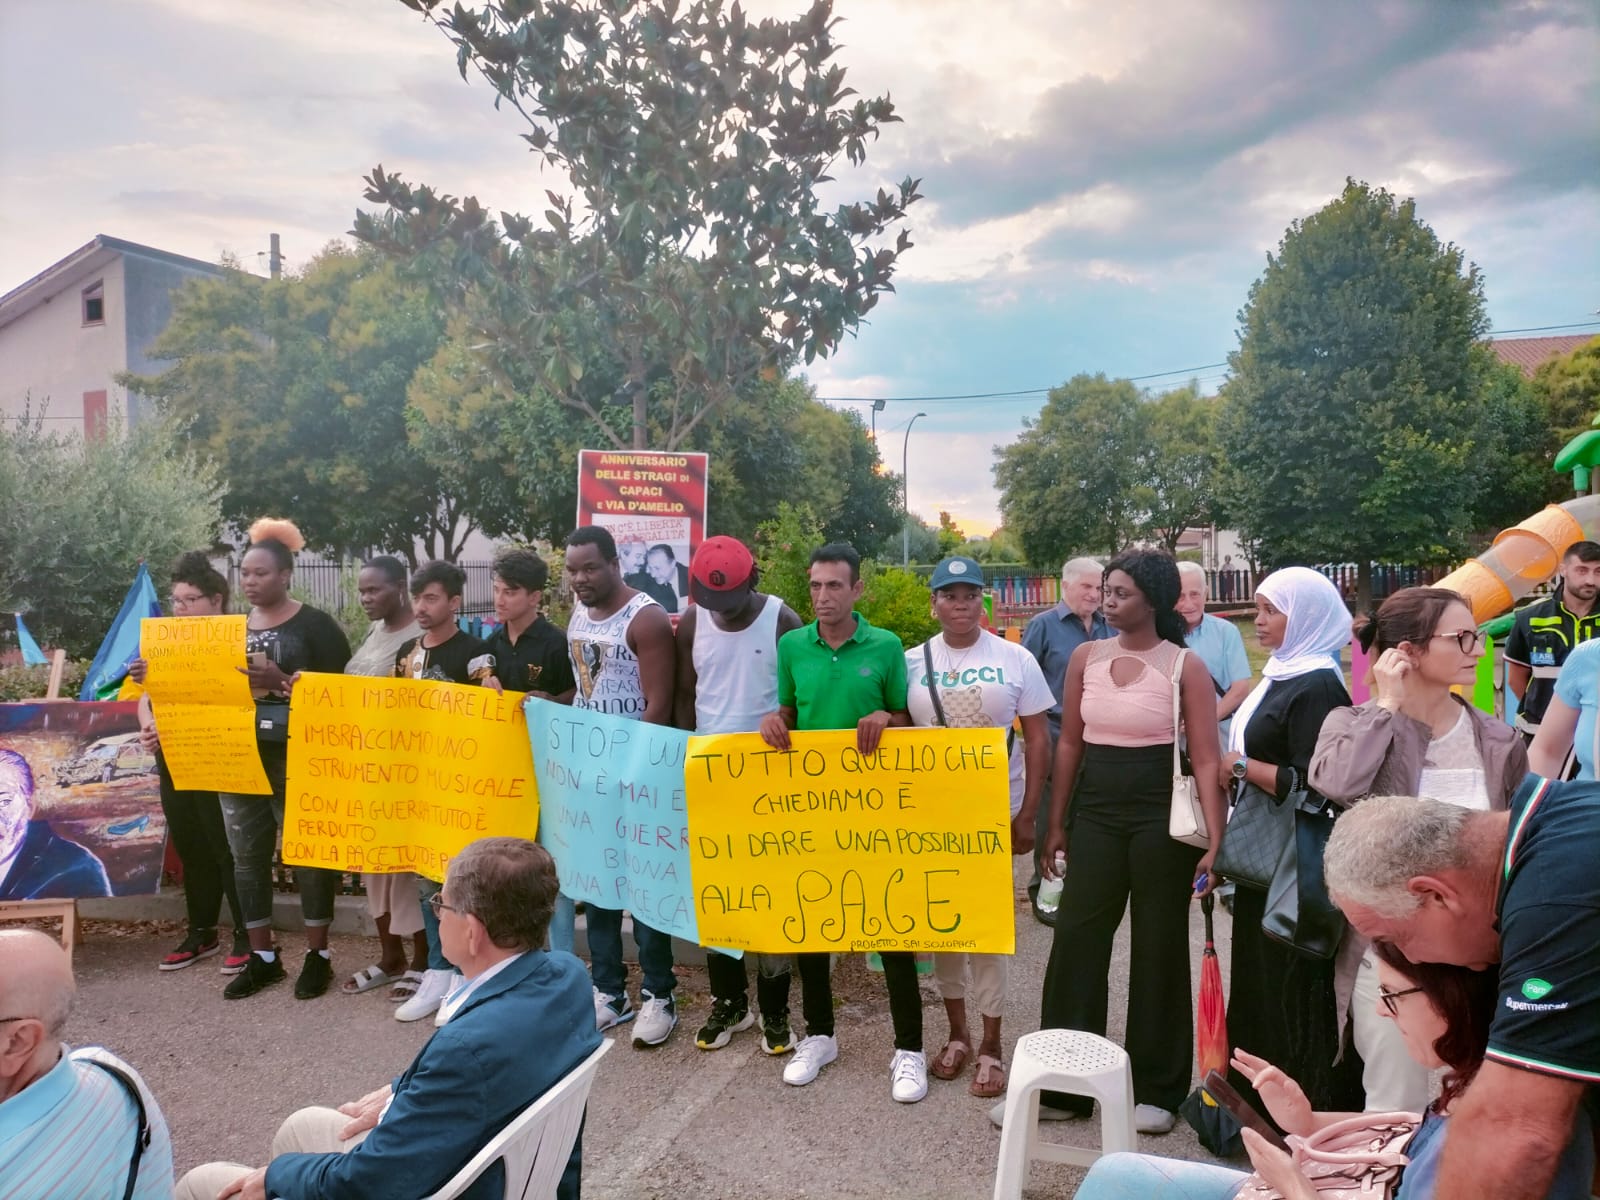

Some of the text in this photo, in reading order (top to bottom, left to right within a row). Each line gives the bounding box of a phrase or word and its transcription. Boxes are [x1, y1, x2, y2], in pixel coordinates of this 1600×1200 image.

[595, 470, 631, 480] DELLE
[633, 471, 677, 482] STRAGI
[600, 454, 687, 467] ANNIVERSARIO
[605, 500, 626, 510] VIA
[628, 501, 684, 512] D'AMELIO
[619, 485, 663, 496] CAPACI
[206, 622, 242, 642] DELLE
[920, 666, 1006, 687] GUCCI
[303, 687, 345, 708] MAI
[362, 688, 476, 717] IMBRACCIARE
[481, 697, 507, 722] LE
[304, 723, 479, 761] IMBRACCIAMO UNO
[549, 718, 686, 769] STOP W
[308, 757, 526, 798] STRUMENTO MUSICALE
[691, 744, 997, 783] TUTTO QUELLO CHE
[544, 759, 582, 790] NON
[595, 768, 608, 795] È
[618, 779, 658, 809] MAI
[299, 792, 338, 813] CON
[347, 800, 364, 818] LA
[753, 788, 883, 816] CHIEDIAMO
[298, 819, 377, 842] PERDUTO
[615, 816, 689, 851] GUERR
[699, 822, 1006, 859] DI DARE UNA POSSIBILITÀ
[284, 841, 315, 861] CON
[320, 845, 339, 861] LA
[346, 845, 391, 867] PACE
[439, 852, 449, 873] P
[604, 848, 679, 884] BUONA
[657, 894, 695, 924] CA
[701, 868, 962, 944] ALLA PACE
[850, 938, 898, 951] PROGETTO
[903, 939, 920, 949] SAI
